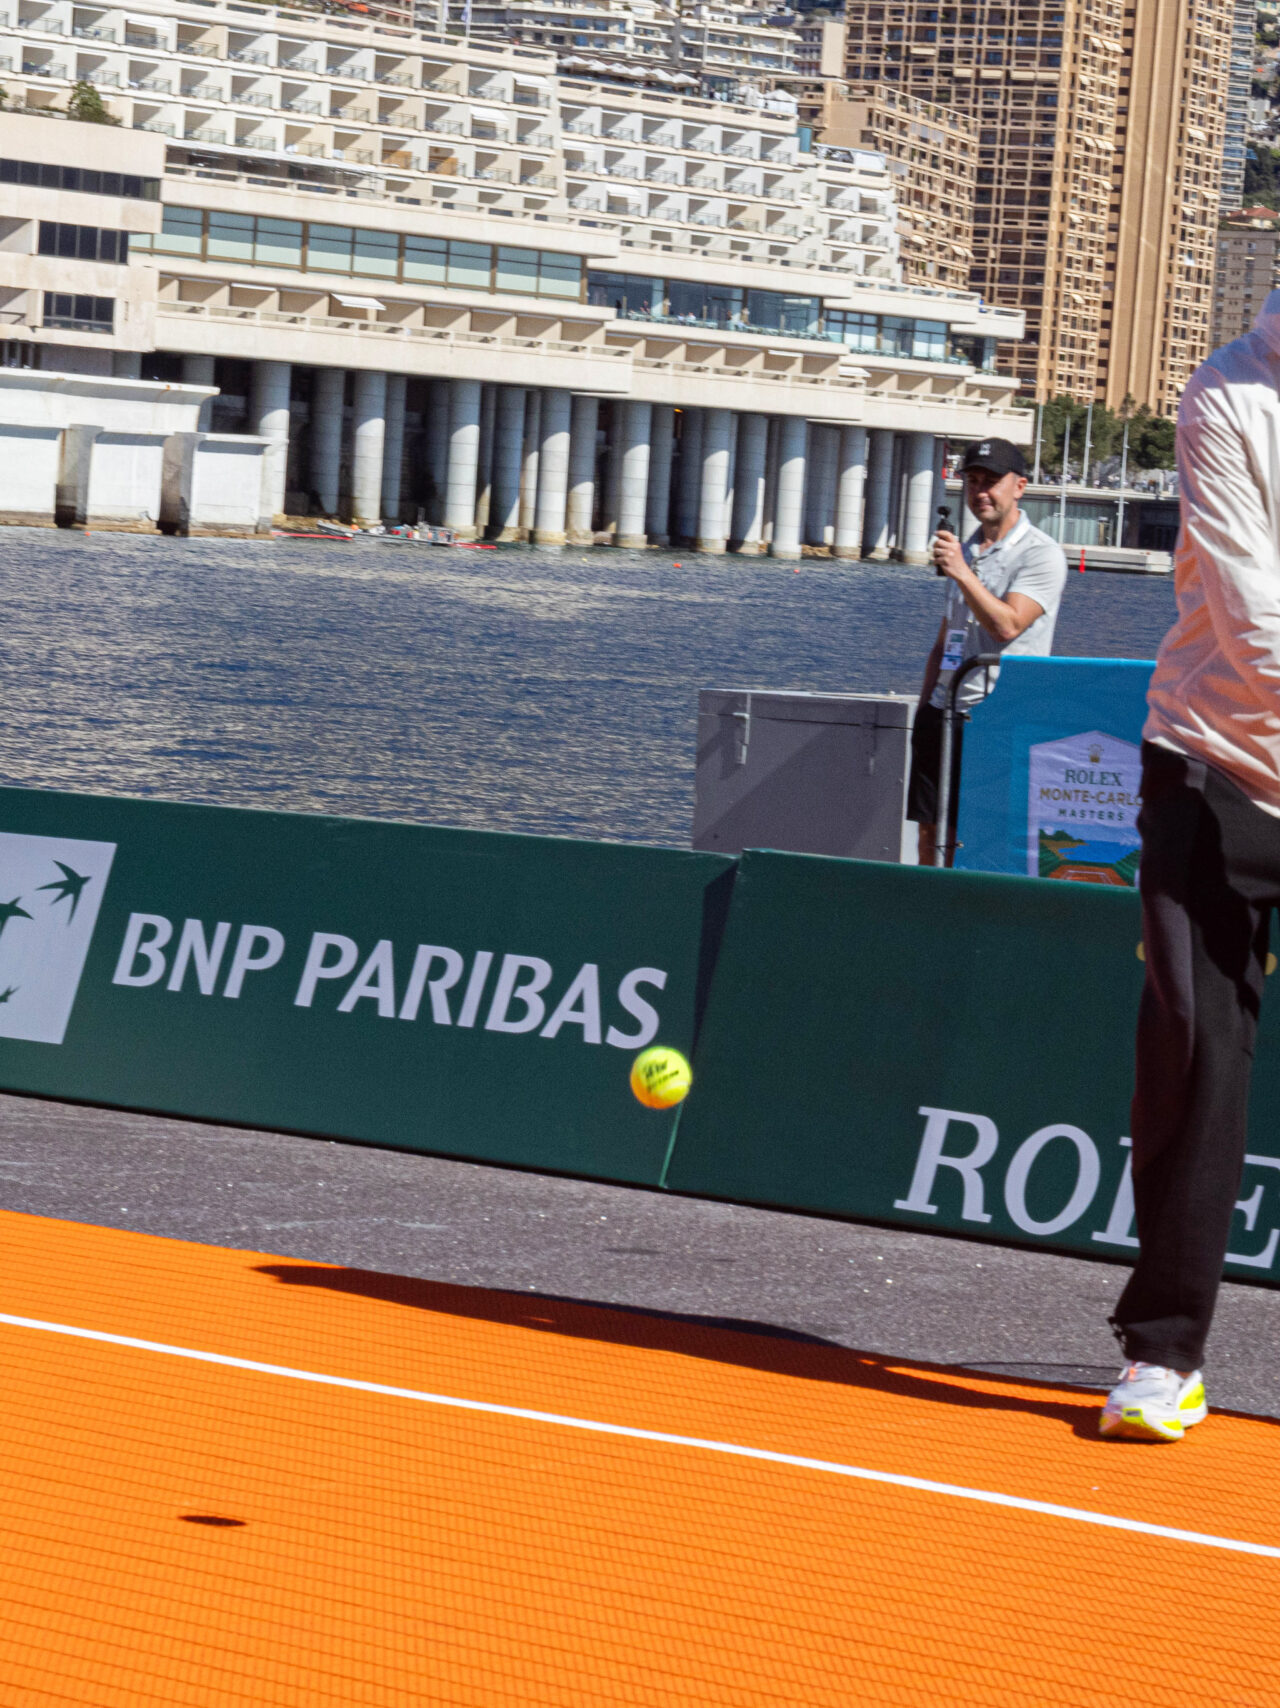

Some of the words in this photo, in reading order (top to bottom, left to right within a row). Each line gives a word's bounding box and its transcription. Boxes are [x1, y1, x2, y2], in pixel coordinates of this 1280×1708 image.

[1064, 768, 1123, 787] ROLEX
[1040, 787, 1144, 807] MONTE-CARLO
[1058, 807, 1125, 822] MASTERS
[112, 912, 286, 999] BNP
[294, 931, 668, 1050] PARIBAS
